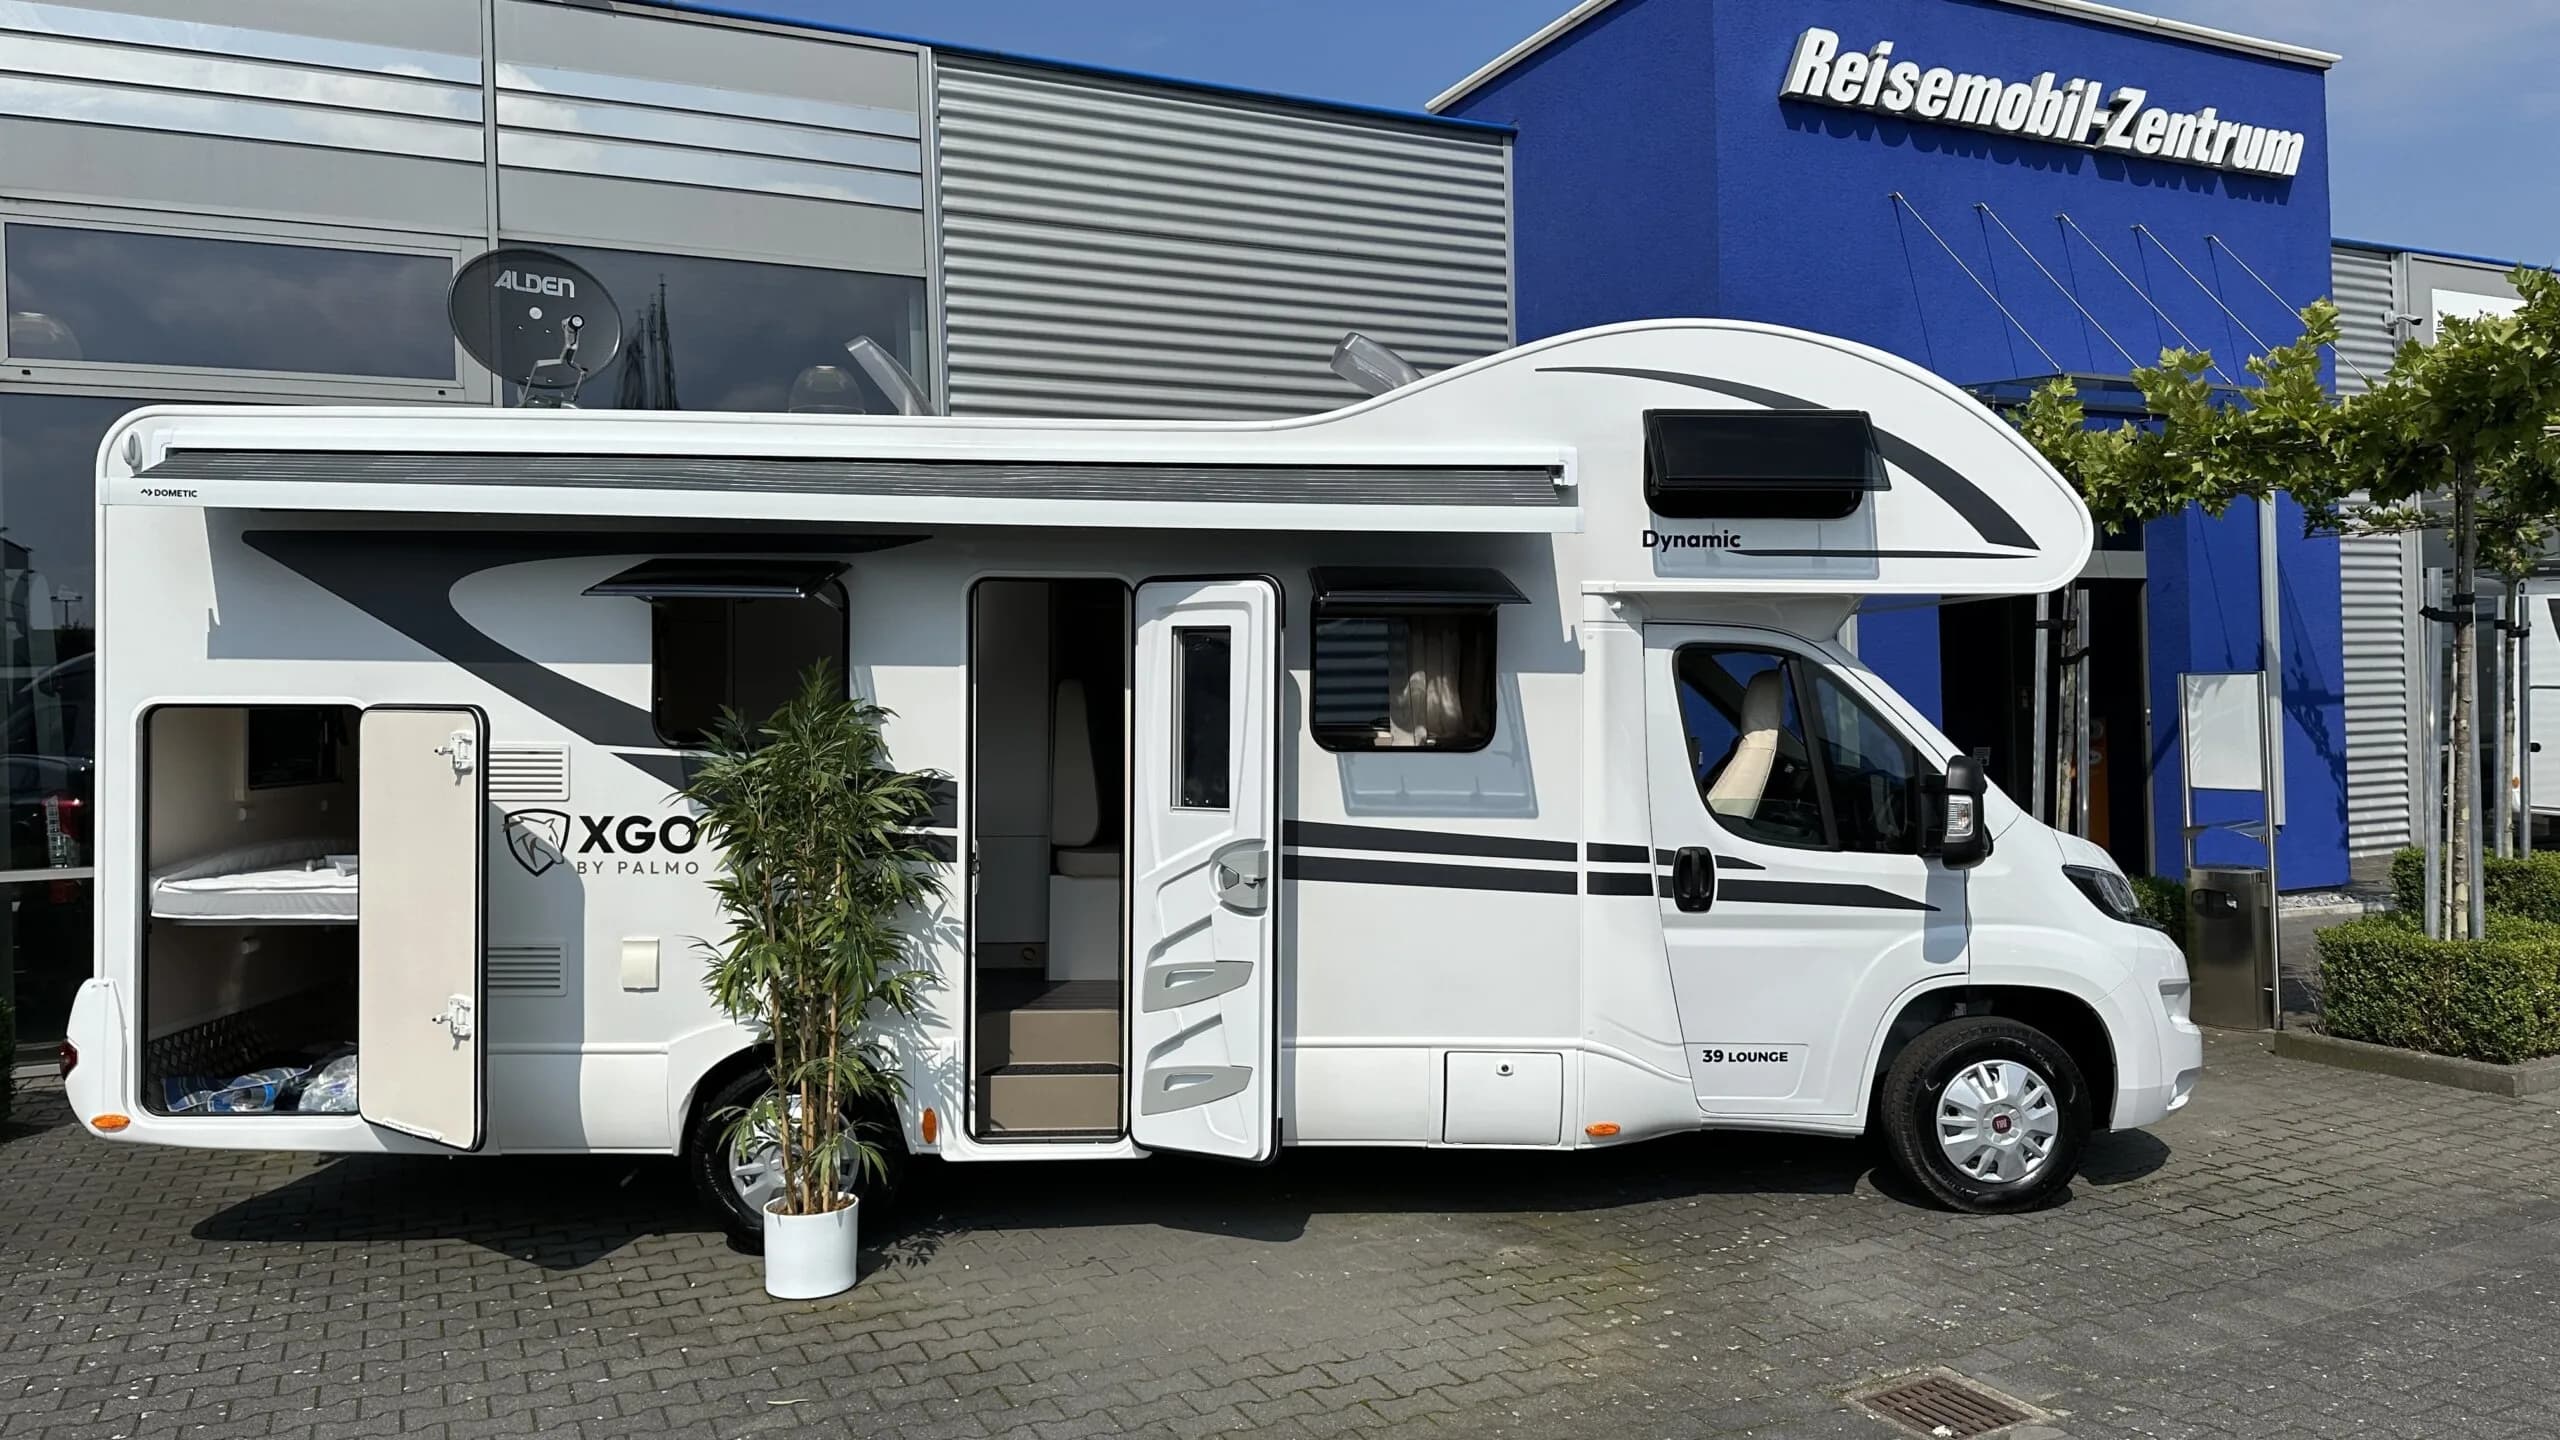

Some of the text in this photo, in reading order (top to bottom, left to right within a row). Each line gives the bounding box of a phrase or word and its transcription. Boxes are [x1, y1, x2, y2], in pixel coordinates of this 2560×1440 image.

[1782, 26, 2305, 177] Reisemobil-Zentrum
[494, 269, 575, 299] ALDEN
[154, 488, 198, 498] DOMETIC
[1642, 529, 1741, 552] Dynamic
[577, 815, 700, 854] XGO
[576, 861, 699, 875] BY PALMO
[1702, 1049, 1789, 1063] 39 LOUNGE
